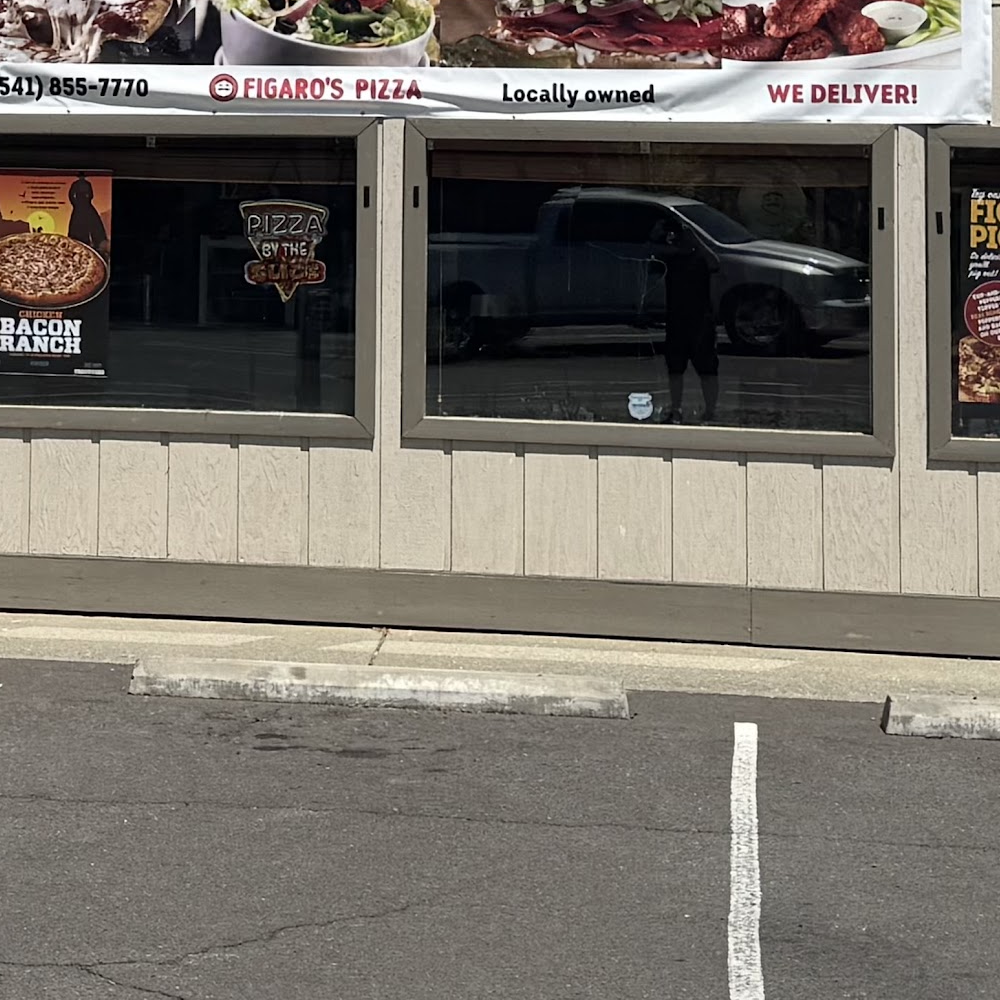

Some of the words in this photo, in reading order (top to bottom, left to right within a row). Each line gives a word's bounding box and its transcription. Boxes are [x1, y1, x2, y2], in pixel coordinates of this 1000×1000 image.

[48, 76, 149, 98] 855-7770
[242, 77, 344, 100] FIGARO'S
[355, 78, 422, 100] PIZZA
[502, 83, 579, 108] Locally
[584, 84, 655, 105] owned
[767, 84, 804, 104] WE
[810, 84, 918, 105] DELIVER!
[247, 214, 324, 235] PIZZA
[261, 242, 280, 258] BY
[281, 242, 308, 257] THE
[18, 310, 64, 319] CHICKEN
[0, 317, 83, 337] BACON
